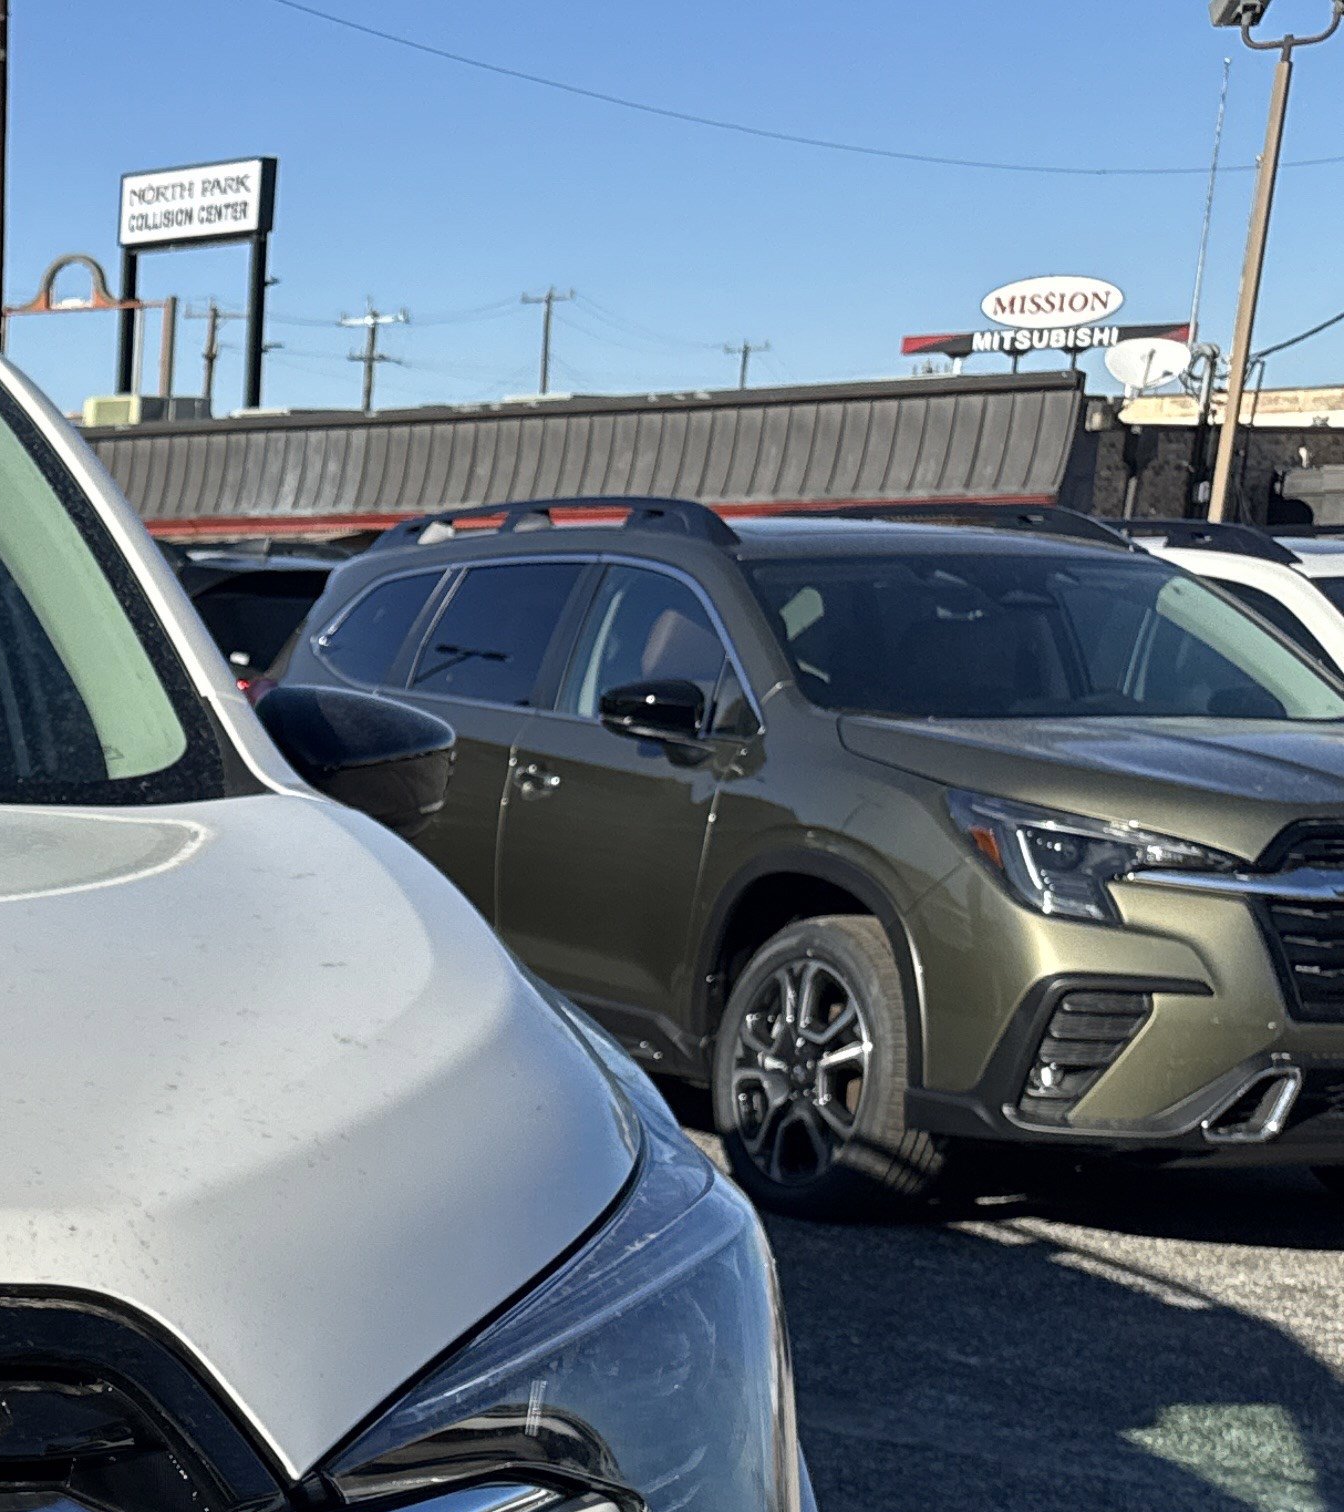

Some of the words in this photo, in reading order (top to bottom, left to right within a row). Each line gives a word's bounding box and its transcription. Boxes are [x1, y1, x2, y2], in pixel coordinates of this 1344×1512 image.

[130, 181, 195, 207] NORTH
[201, 174, 251, 197] PARK
[128, 207, 194, 233] COLLISION
[197, 200, 249, 225] CENTER
[993, 291, 1111, 315] MISSION
[972, 326, 1120, 351] MITSUBISHI
